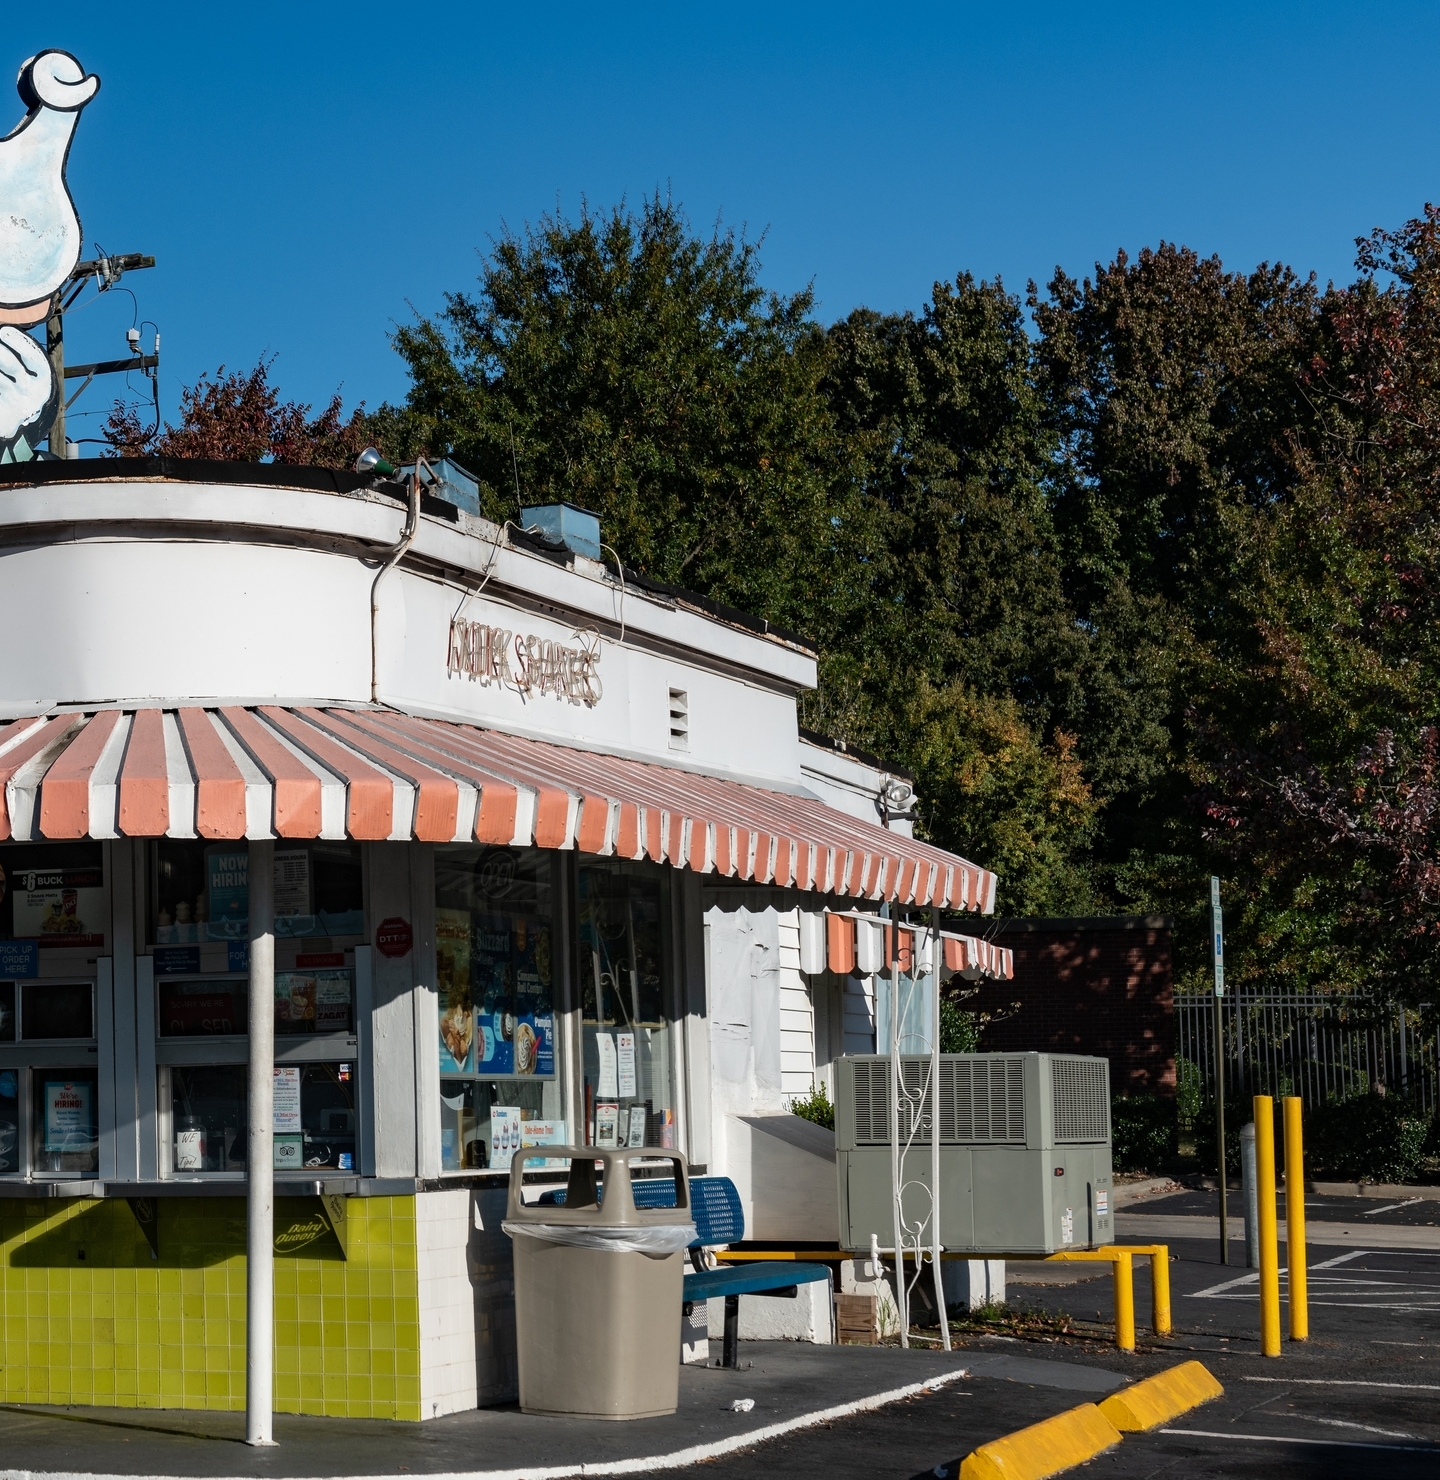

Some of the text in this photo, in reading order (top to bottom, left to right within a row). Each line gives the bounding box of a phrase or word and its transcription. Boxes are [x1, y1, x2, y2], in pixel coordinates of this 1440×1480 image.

[219, 856, 248, 871] NOW
[480, 861, 514, 888] OPEN
[22, 872, 97, 892] $6 BUCK LUNCH
[65, 899, 76, 909] DQ
[476, 927, 510, 952] Blizzard
[0, 945, 33, 954] PICK UP
[2, 955, 30, 964] ORDER
[229, 952, 245, 960] FOR
[5, 965, 28, 973] HERE
[317, 1012, 346, 1020] ZAGAT
[171, 1018, 232, 1036] CLSED
[59, 1092, 78, 1100] We're
[54, 1100, 83, 1108] HIRING!
[182, 1133, 197, 1143] WE
[287, 1221, 322, 1233] Dairy
[275, 1232, 316, 1245] Queen
